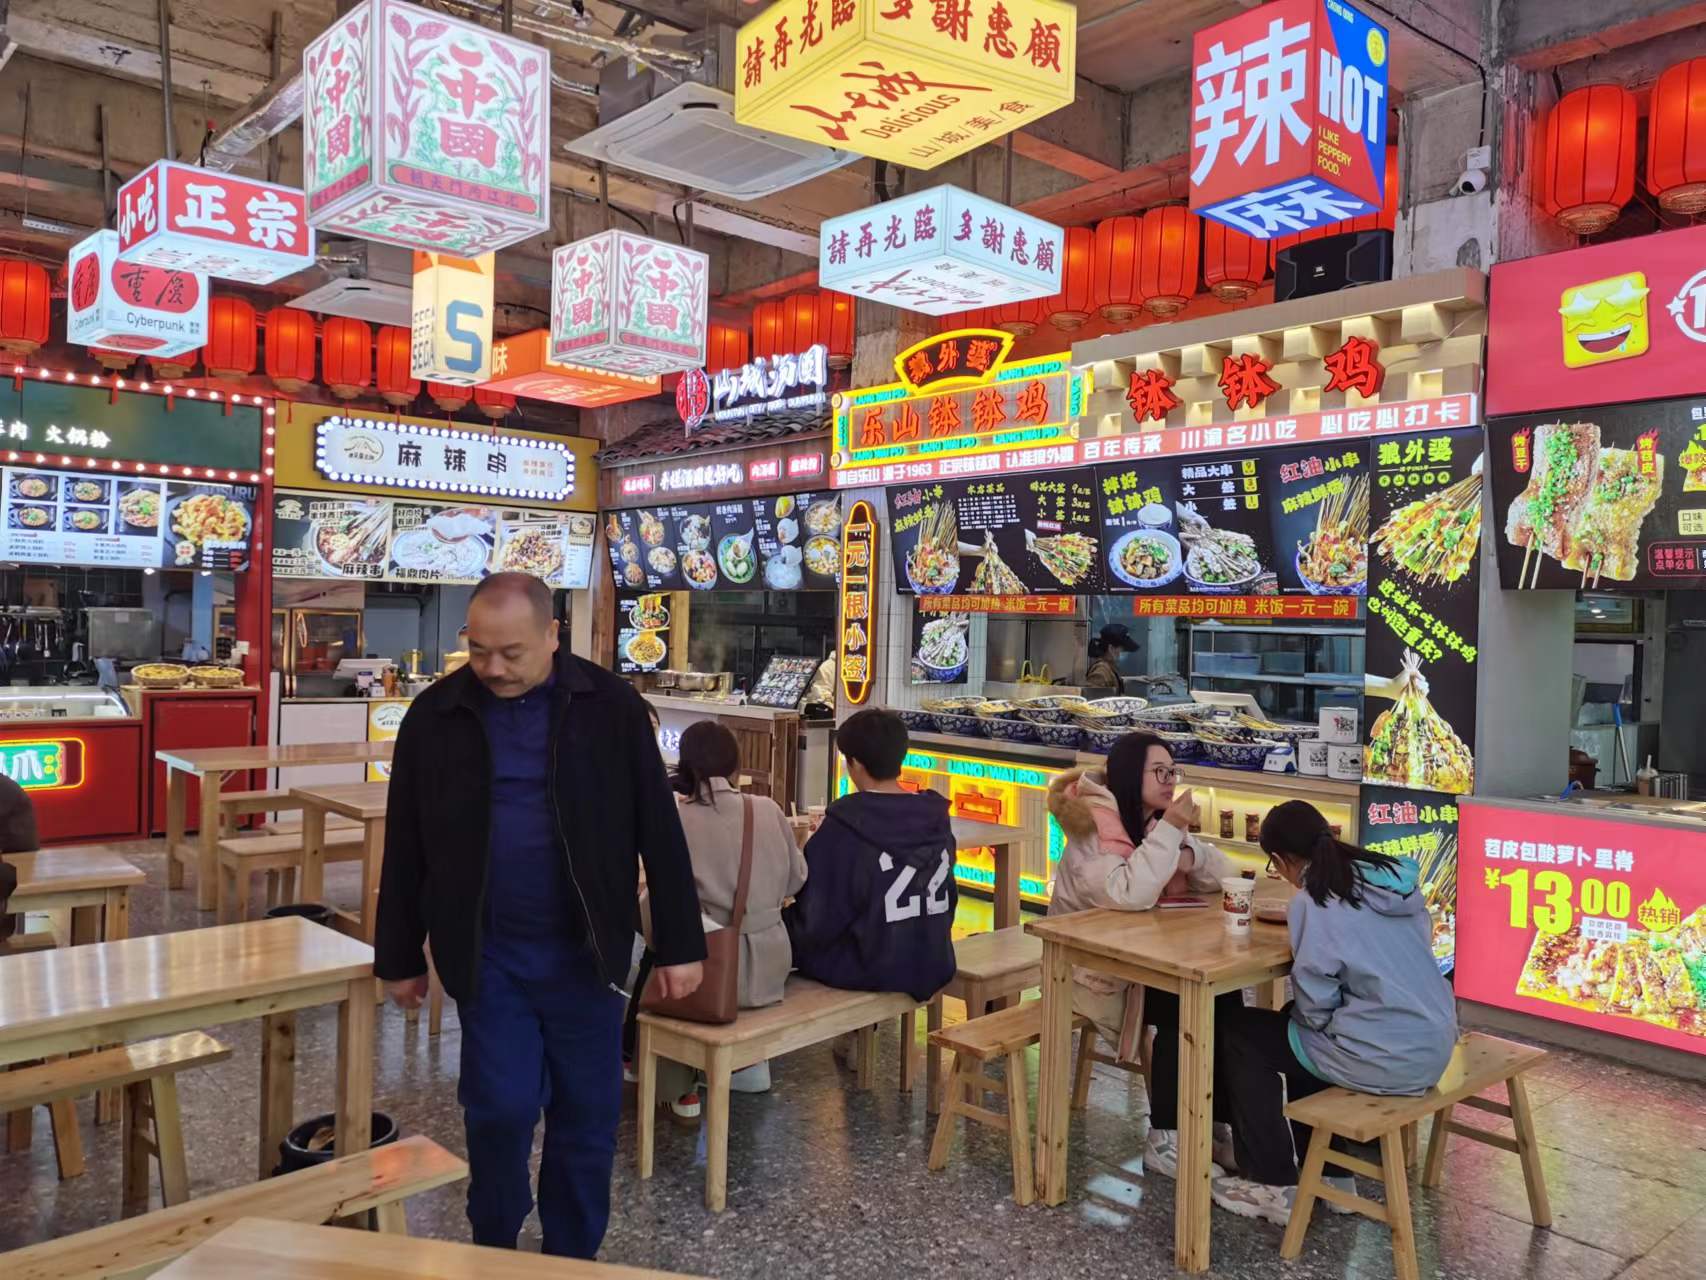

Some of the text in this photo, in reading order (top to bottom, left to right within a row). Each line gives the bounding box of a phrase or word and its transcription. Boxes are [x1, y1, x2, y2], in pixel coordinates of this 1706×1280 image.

[436, 67, 498, 169] 中國
[860, 93, 961, 140] Delicious
[1190, 18, 1312, 187] 辣
[1319, 48, 1383, 144] HOT
[1318, 142, 1352, 167] PEPPERY
[1323, 127, 1340, 146] LIKE
[1317, 157, 1341, 177] FOOD.
[120, 176, 157, 245] 小吃
[174, 182, 298, 249] 正宗
[826, 203, 938, 265] 請再光臨
[953, 208, 1056, 275] 多謝惠顧
[126, 311, 185, 333] Cyberpunk
[444, 299, 483, 374] S
[1126, 335, 1386, 422] 钵钵鸡
[861, 381, 1049, 447] 乐山钵钵鸡
[1083, 402, 1461, 461] 百年传承 川渝名小吃 必吃必打卡
[398, 441, 507, 479] 麻辣串
[1280, 452, 1360, 484] 红油小串
[1378, 436, 1453, 466] 狼外婆
[1655, 549, 1695, 560] 温馨提示
[1138, 598, 1350, 617] 所有菜品均可加热 米饭一元一碗
[950, 758, 1041, 785] LANG WAI PO
[1368, 800, 1459, 825] 红油小串
[1484, 867, 1631, 936] ¥13.00
[1639, 905, 1681, 927] 热销
